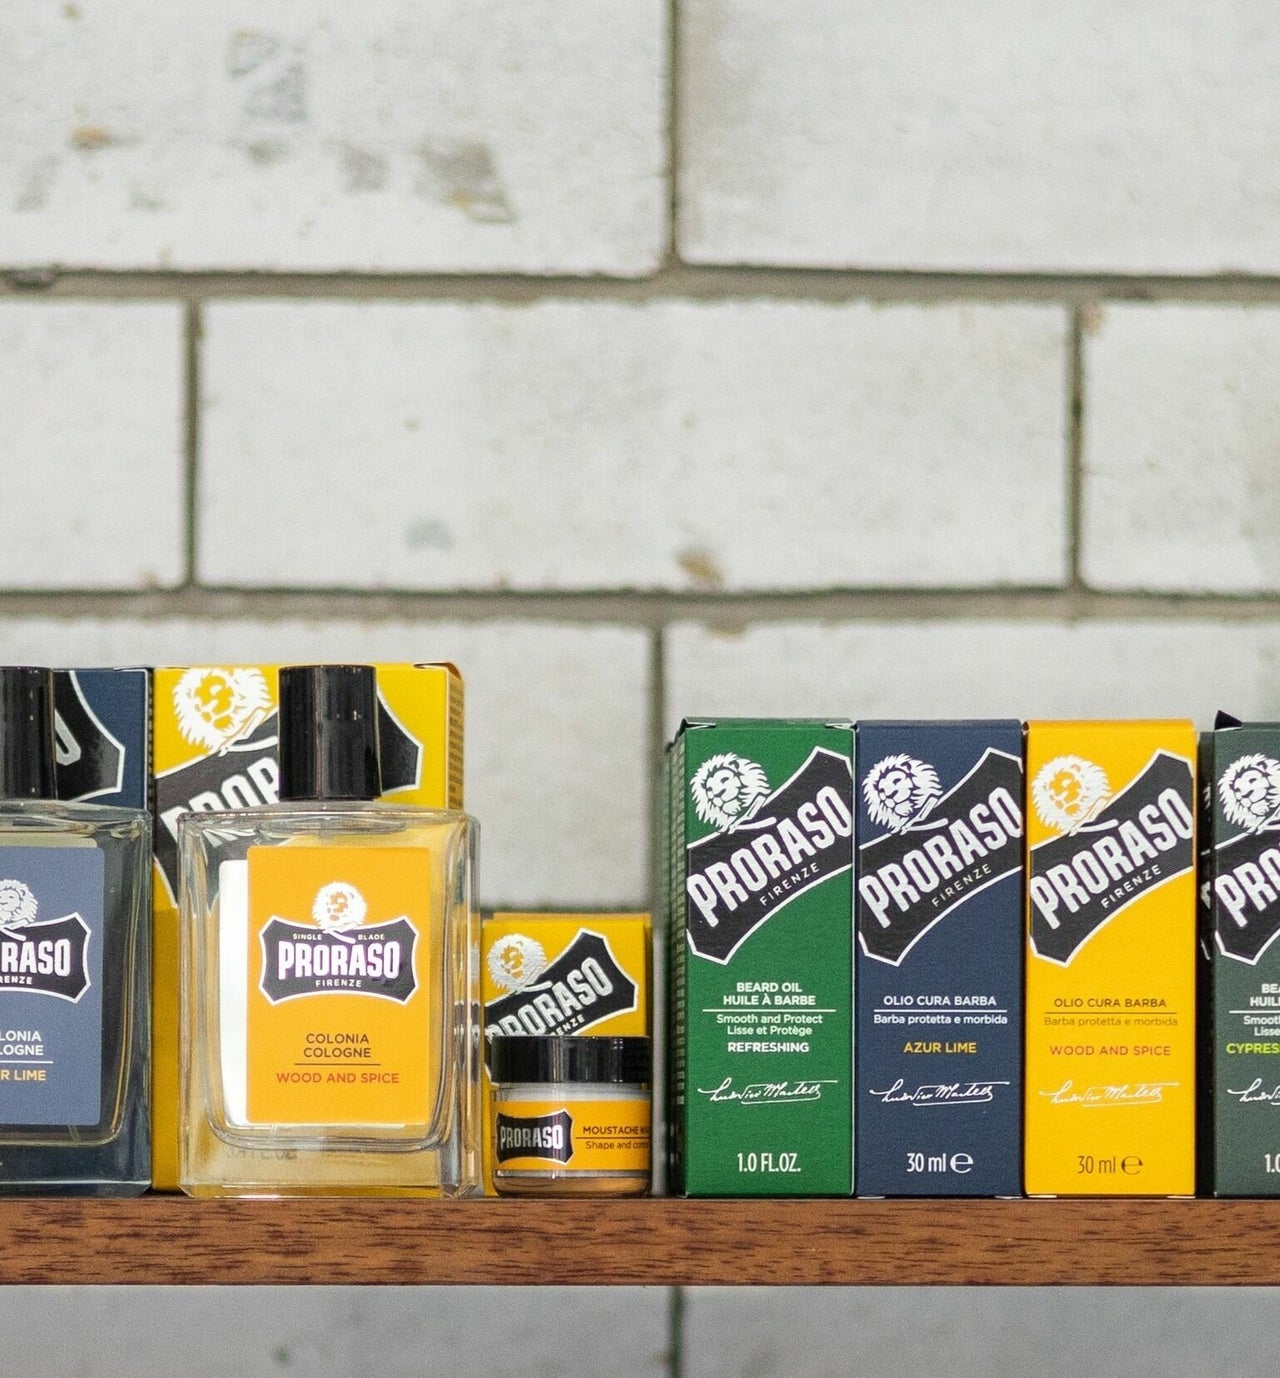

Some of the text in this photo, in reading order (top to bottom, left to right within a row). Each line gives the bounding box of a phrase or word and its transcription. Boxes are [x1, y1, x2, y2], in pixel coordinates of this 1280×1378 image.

[687, 786, 852, 928] PRORASO
[858, 787, 1022, 929] PRORASO
[1030, 788, 1193, 930] PRORASO
[759, 862, 820, 906] FIRENZE
[278, 941, 400, 980] PRORASO
[737, 982, 802, 992] BEARD OIL
[723, 994, 815, 1005] HUILE À BARBE
[717, 1014, 823, 1024] Smooth and Protect
[727, 1025, 812, 1036] Lisse et Protège
[306, 1033, 369, 1044] COLONIA
[303, 1047, 371, 1058] COLOGNE
[728, 1042, 809, 1053] REFRESHING
[15, 1069, 46, 1081] LIME
[276, 1072, 399, 1084] WOOD AND SPICE
[583, 1126, 638, 1135] MOUSTACHE
[500, 1125, 563, 1149] PRORASO
[737, 1153, 800, 1172] 1.0 FL.OZ.
